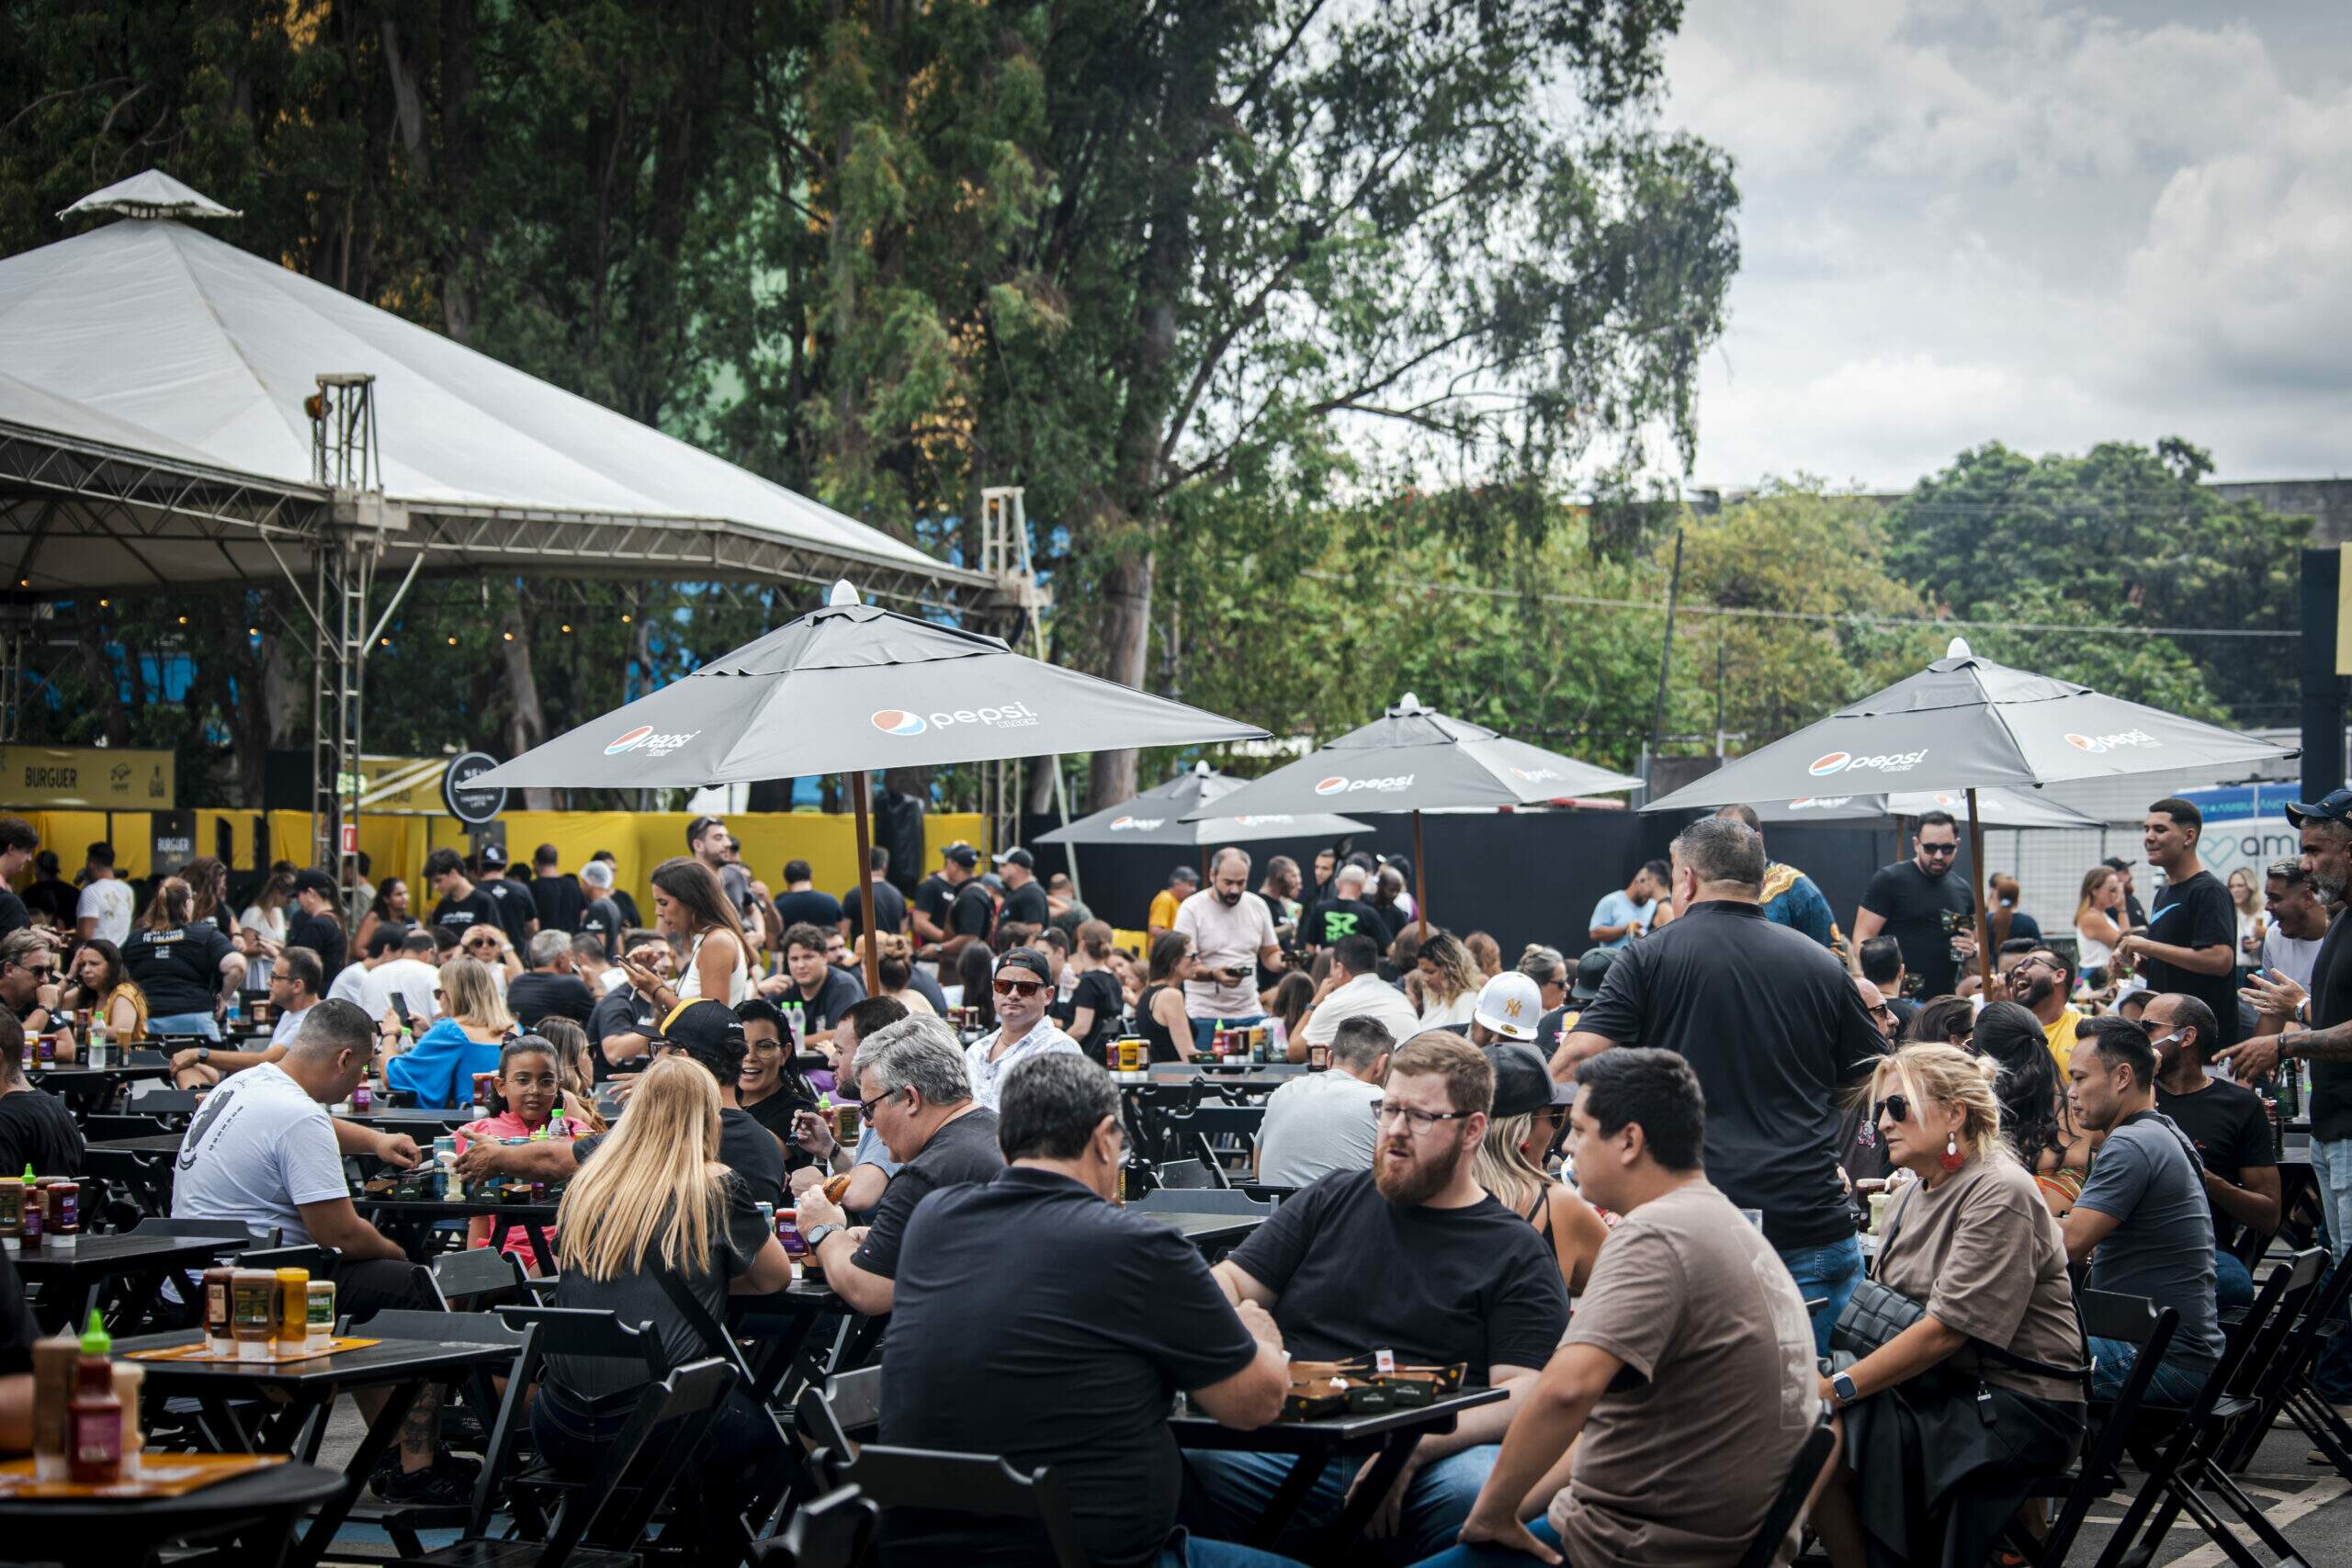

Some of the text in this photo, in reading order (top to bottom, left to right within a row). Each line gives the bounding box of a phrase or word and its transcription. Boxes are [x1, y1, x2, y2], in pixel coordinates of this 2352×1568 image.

[929, 701, 1033, 729] pepsi
[628, 729, 701, 752] pepsi
[1845, 749, 1928, 772] pepsi
[25, 766, 77, 789] BURGUER
[1348, 773, 1414, 792] pepsi
[157, 837, 189, 853] BURGUER
[2241, 835, 2304, 856] am
